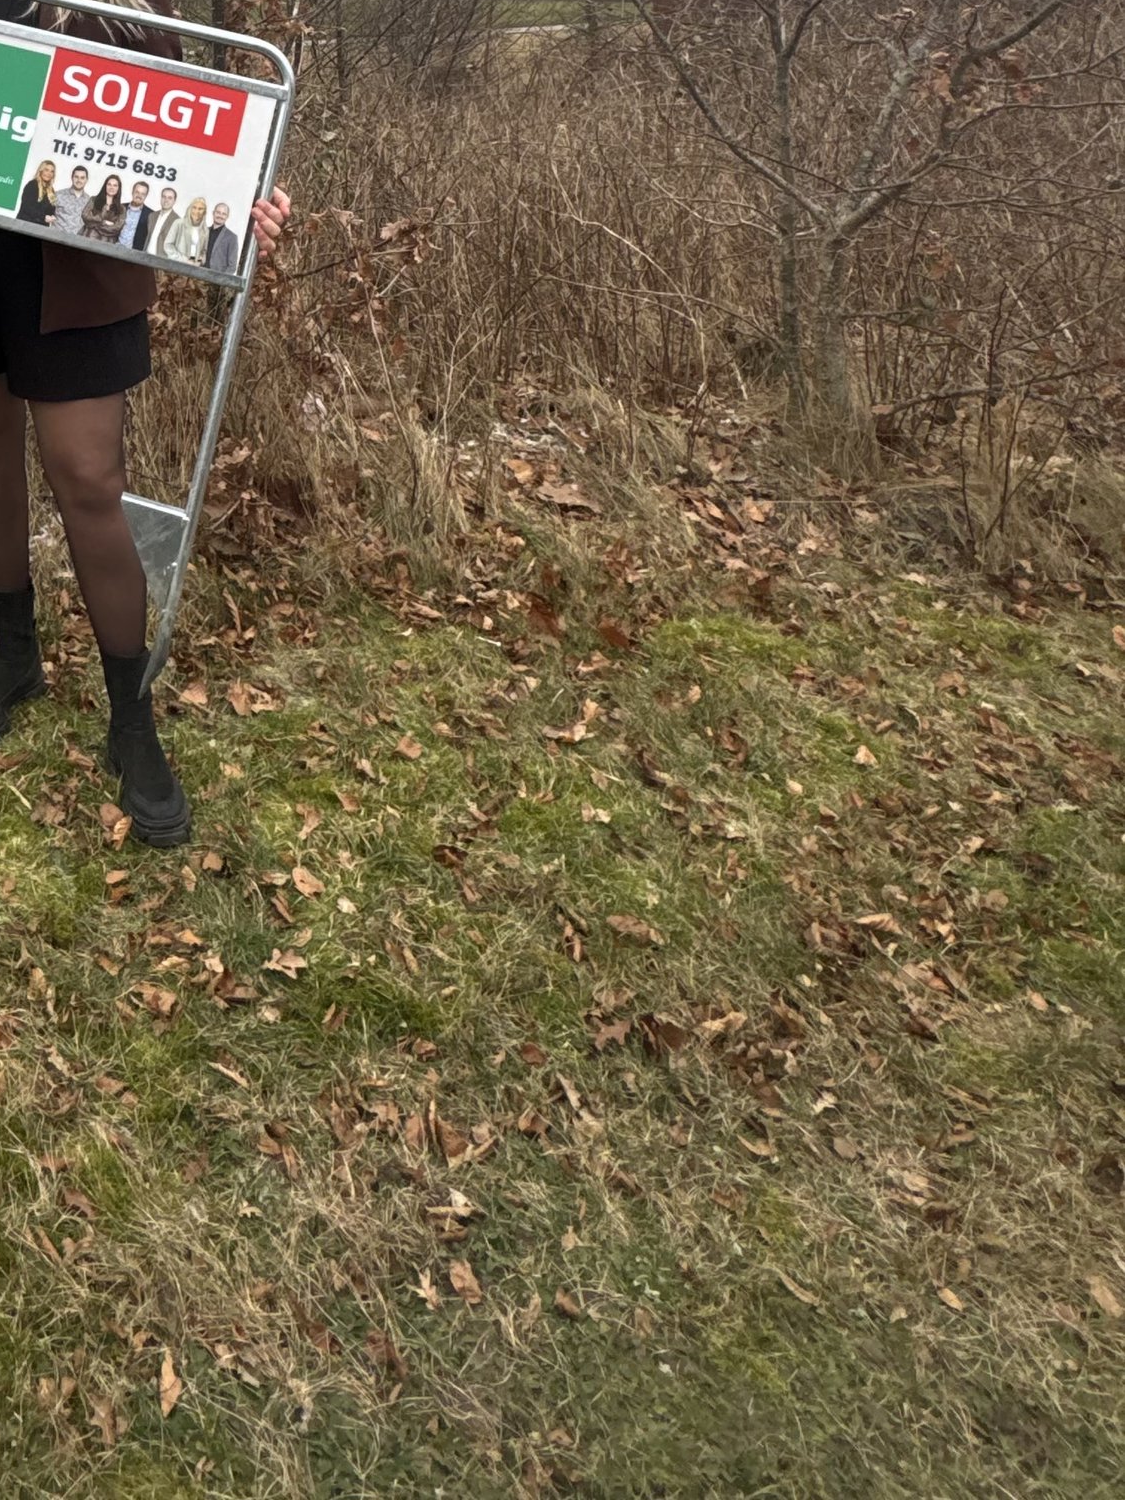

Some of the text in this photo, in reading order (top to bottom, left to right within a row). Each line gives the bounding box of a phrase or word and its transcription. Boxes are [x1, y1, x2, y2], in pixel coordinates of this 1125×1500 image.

[59, 65, 232, 136] SOLGT
[57, 116, 160, 154] Nybolig Ikast
[53, 139, 178, 182] Tlf. 9715 6833
